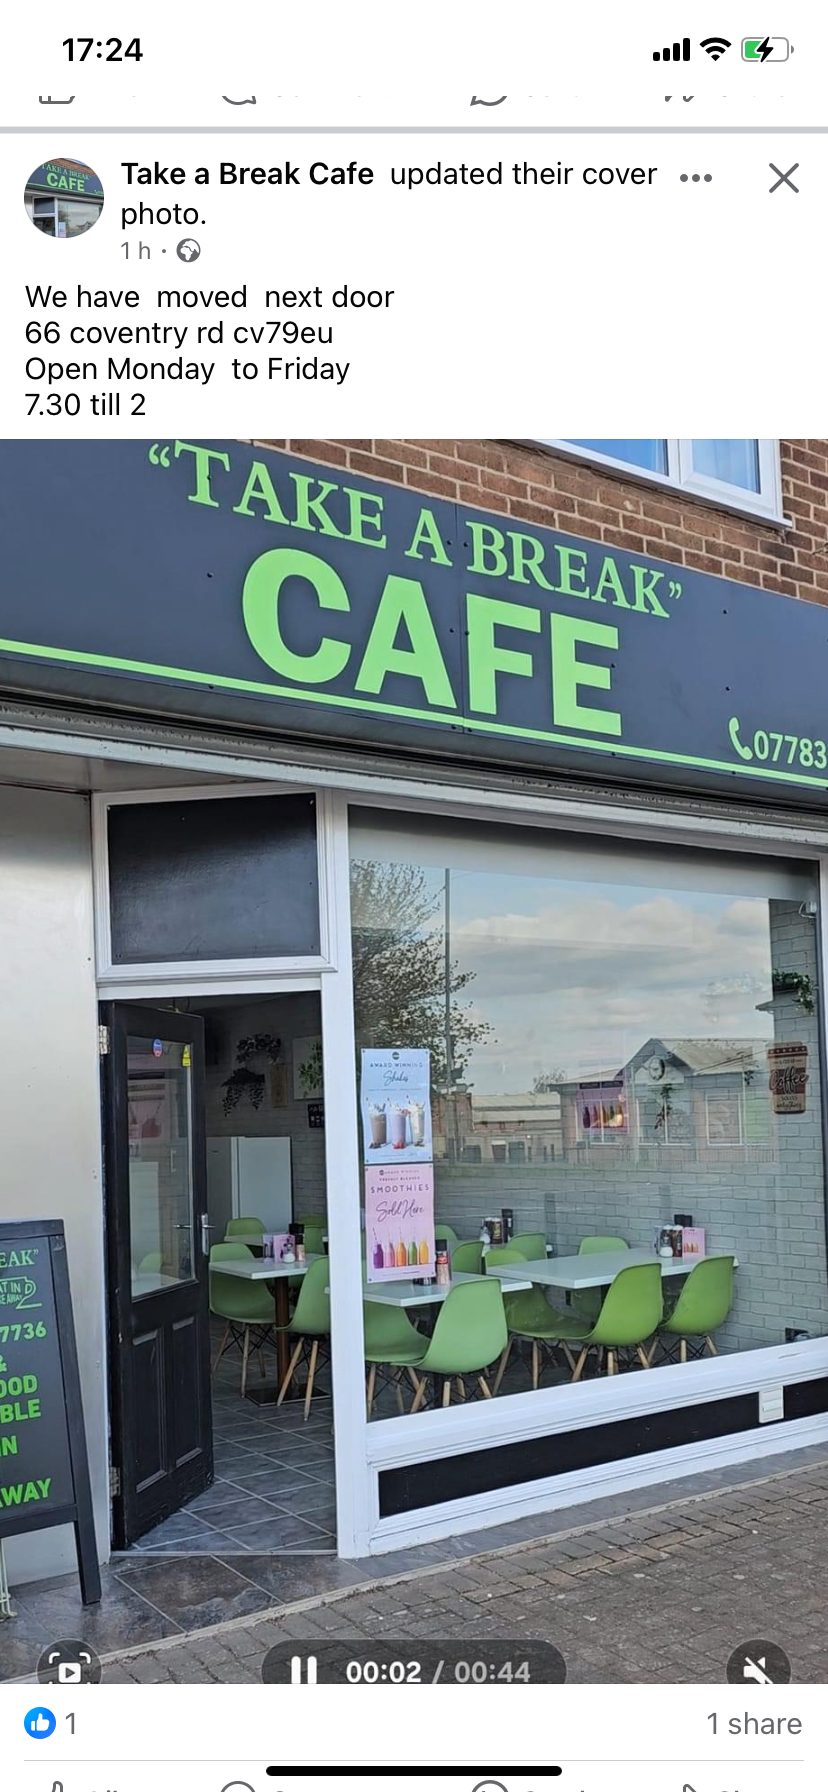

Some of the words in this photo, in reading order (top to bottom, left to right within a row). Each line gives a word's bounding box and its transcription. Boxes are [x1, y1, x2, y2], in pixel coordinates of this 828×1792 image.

[46, 172, 85, 192] CAFE
[404, 509, 453, 567] A
[242, 548, 622, 736] CAFE
[769, 1065, 810, 1095] Coffee
[370, 1184, 430, 1194] SMOOTHIES
[376, 1200, 402, 1222] Sold
[402, 1199, 424, 1219] Here
